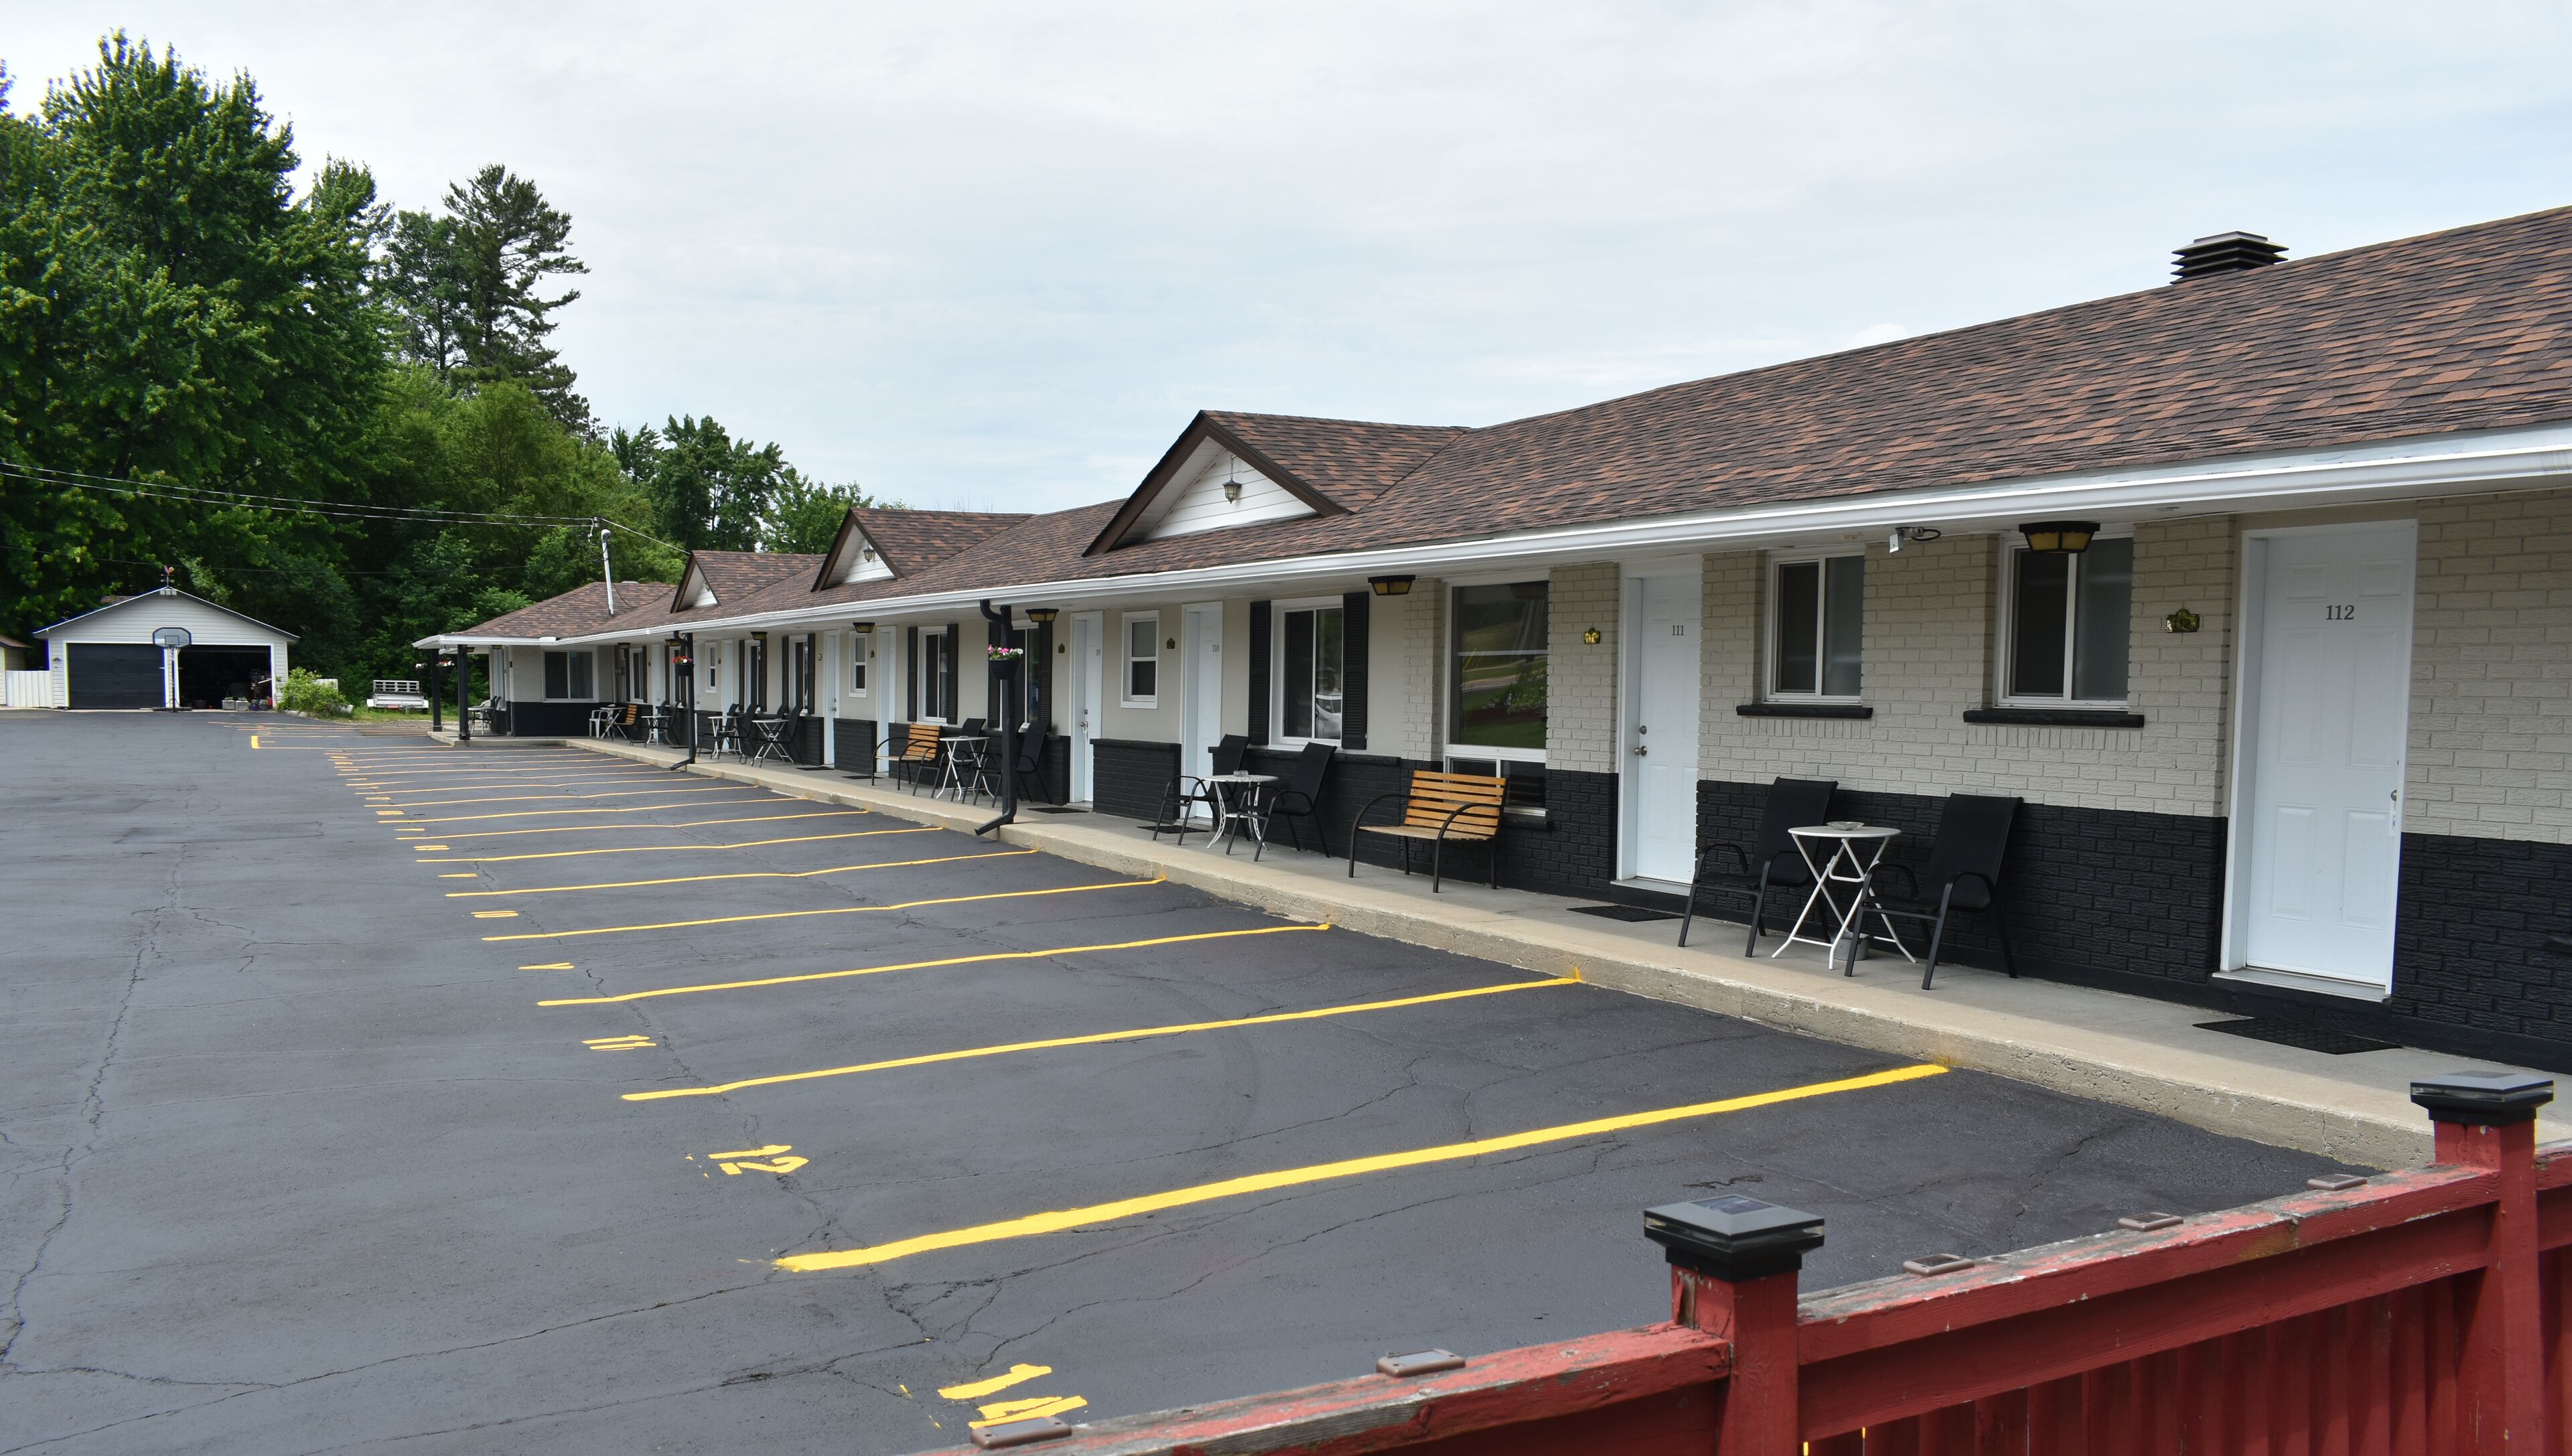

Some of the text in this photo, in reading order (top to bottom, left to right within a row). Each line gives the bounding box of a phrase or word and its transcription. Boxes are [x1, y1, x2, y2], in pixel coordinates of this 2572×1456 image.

[2326, 605, 2355, 620] 112
[1672, 625, 1684, 636] 111
[708, 1145, 809, 1175] 12
